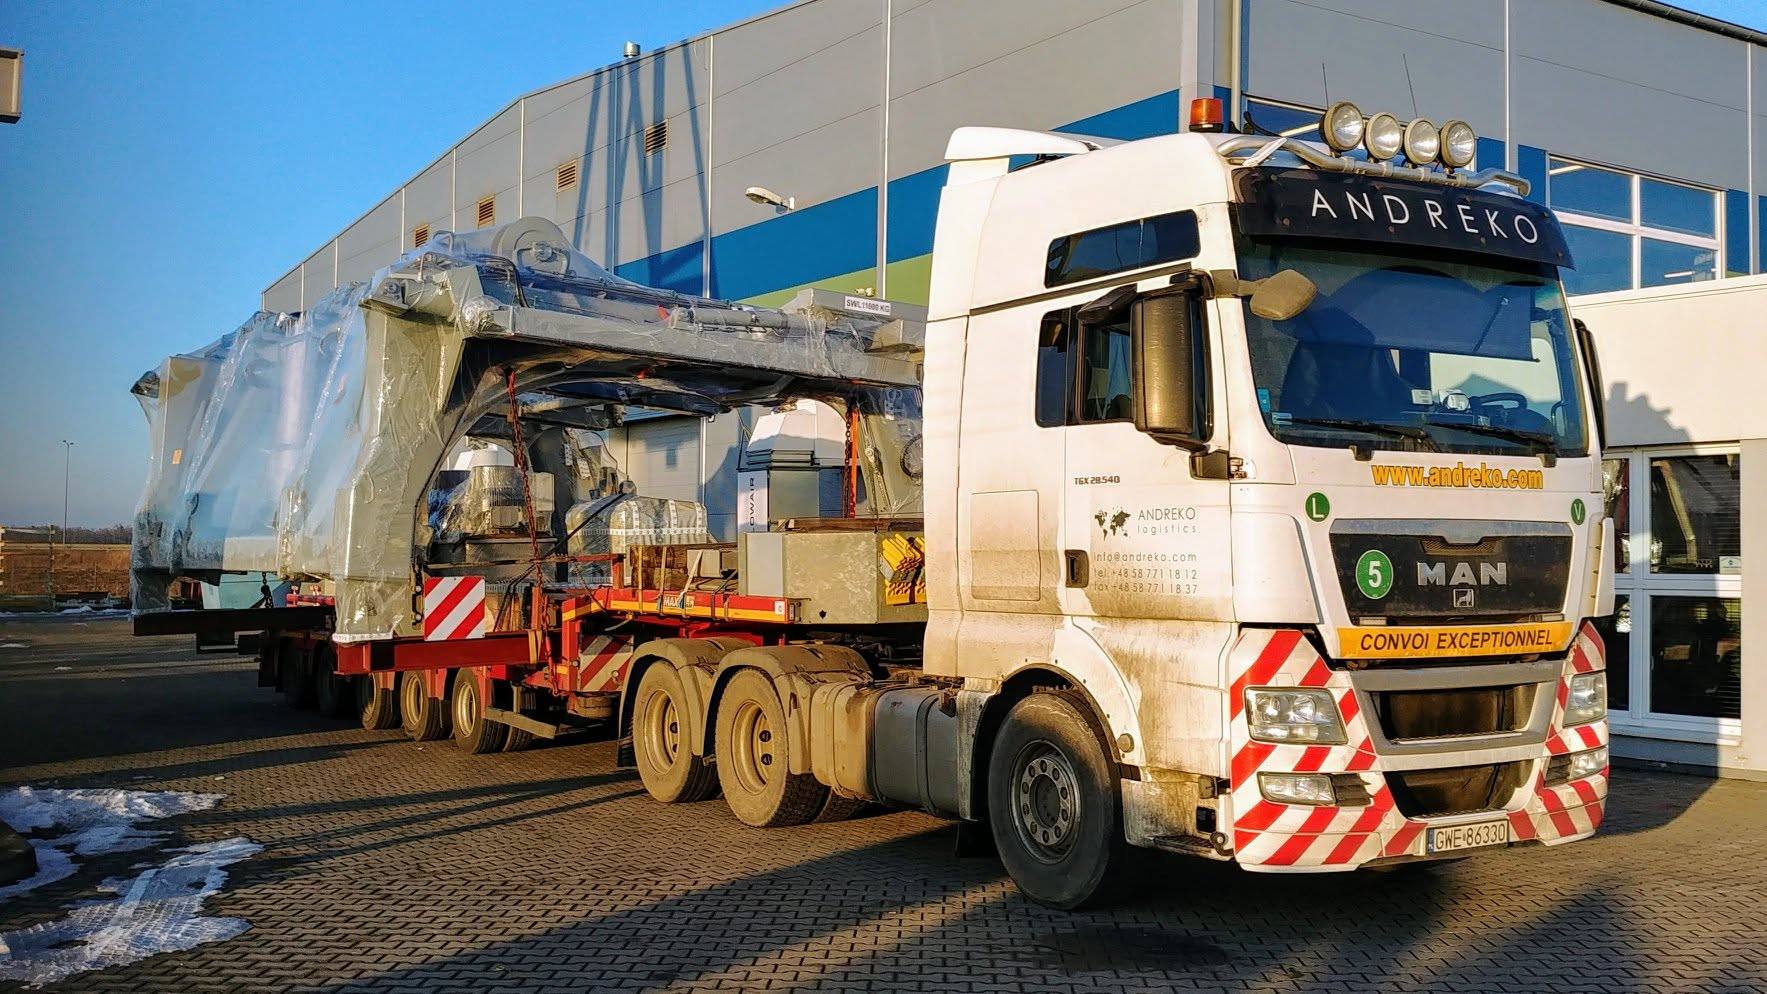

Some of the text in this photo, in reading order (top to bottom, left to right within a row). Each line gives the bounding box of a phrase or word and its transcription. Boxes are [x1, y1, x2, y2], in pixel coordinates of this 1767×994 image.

[1311, 188, 1538, 244] ANDREKO
[1372, 462, 1543, 489] www.andreko.com
[1138, 507, 1196, 521] ANDREKO
[1311, 497, 1325, 519] L
[1573, 502, 1583, 520] V
[1138, 524, 1196, 535] logistics
[1093, 551, 1197, 562] info@andreko.com
[1132, 568, 1143, 579] 58
[1146, 568, 1164, 579] 771
[1169, 569, 1181, 580] 18
[1185, 569, 1198, 580] 12
[1368, 560, 1382, 588] 5
[1417, 562, 1507, 586] MAN
[1132, 582, 1144, 593] 58
[1147, 583, 1164, 593] 771
[1170, 583, 1182, 594] 18
[1185, 584, 1198, 595] 37
[1360, 629, 1553, 651] CONVOI EXCEPTIONNEL
[1436, 823, 1505, 850] GWE 86330
